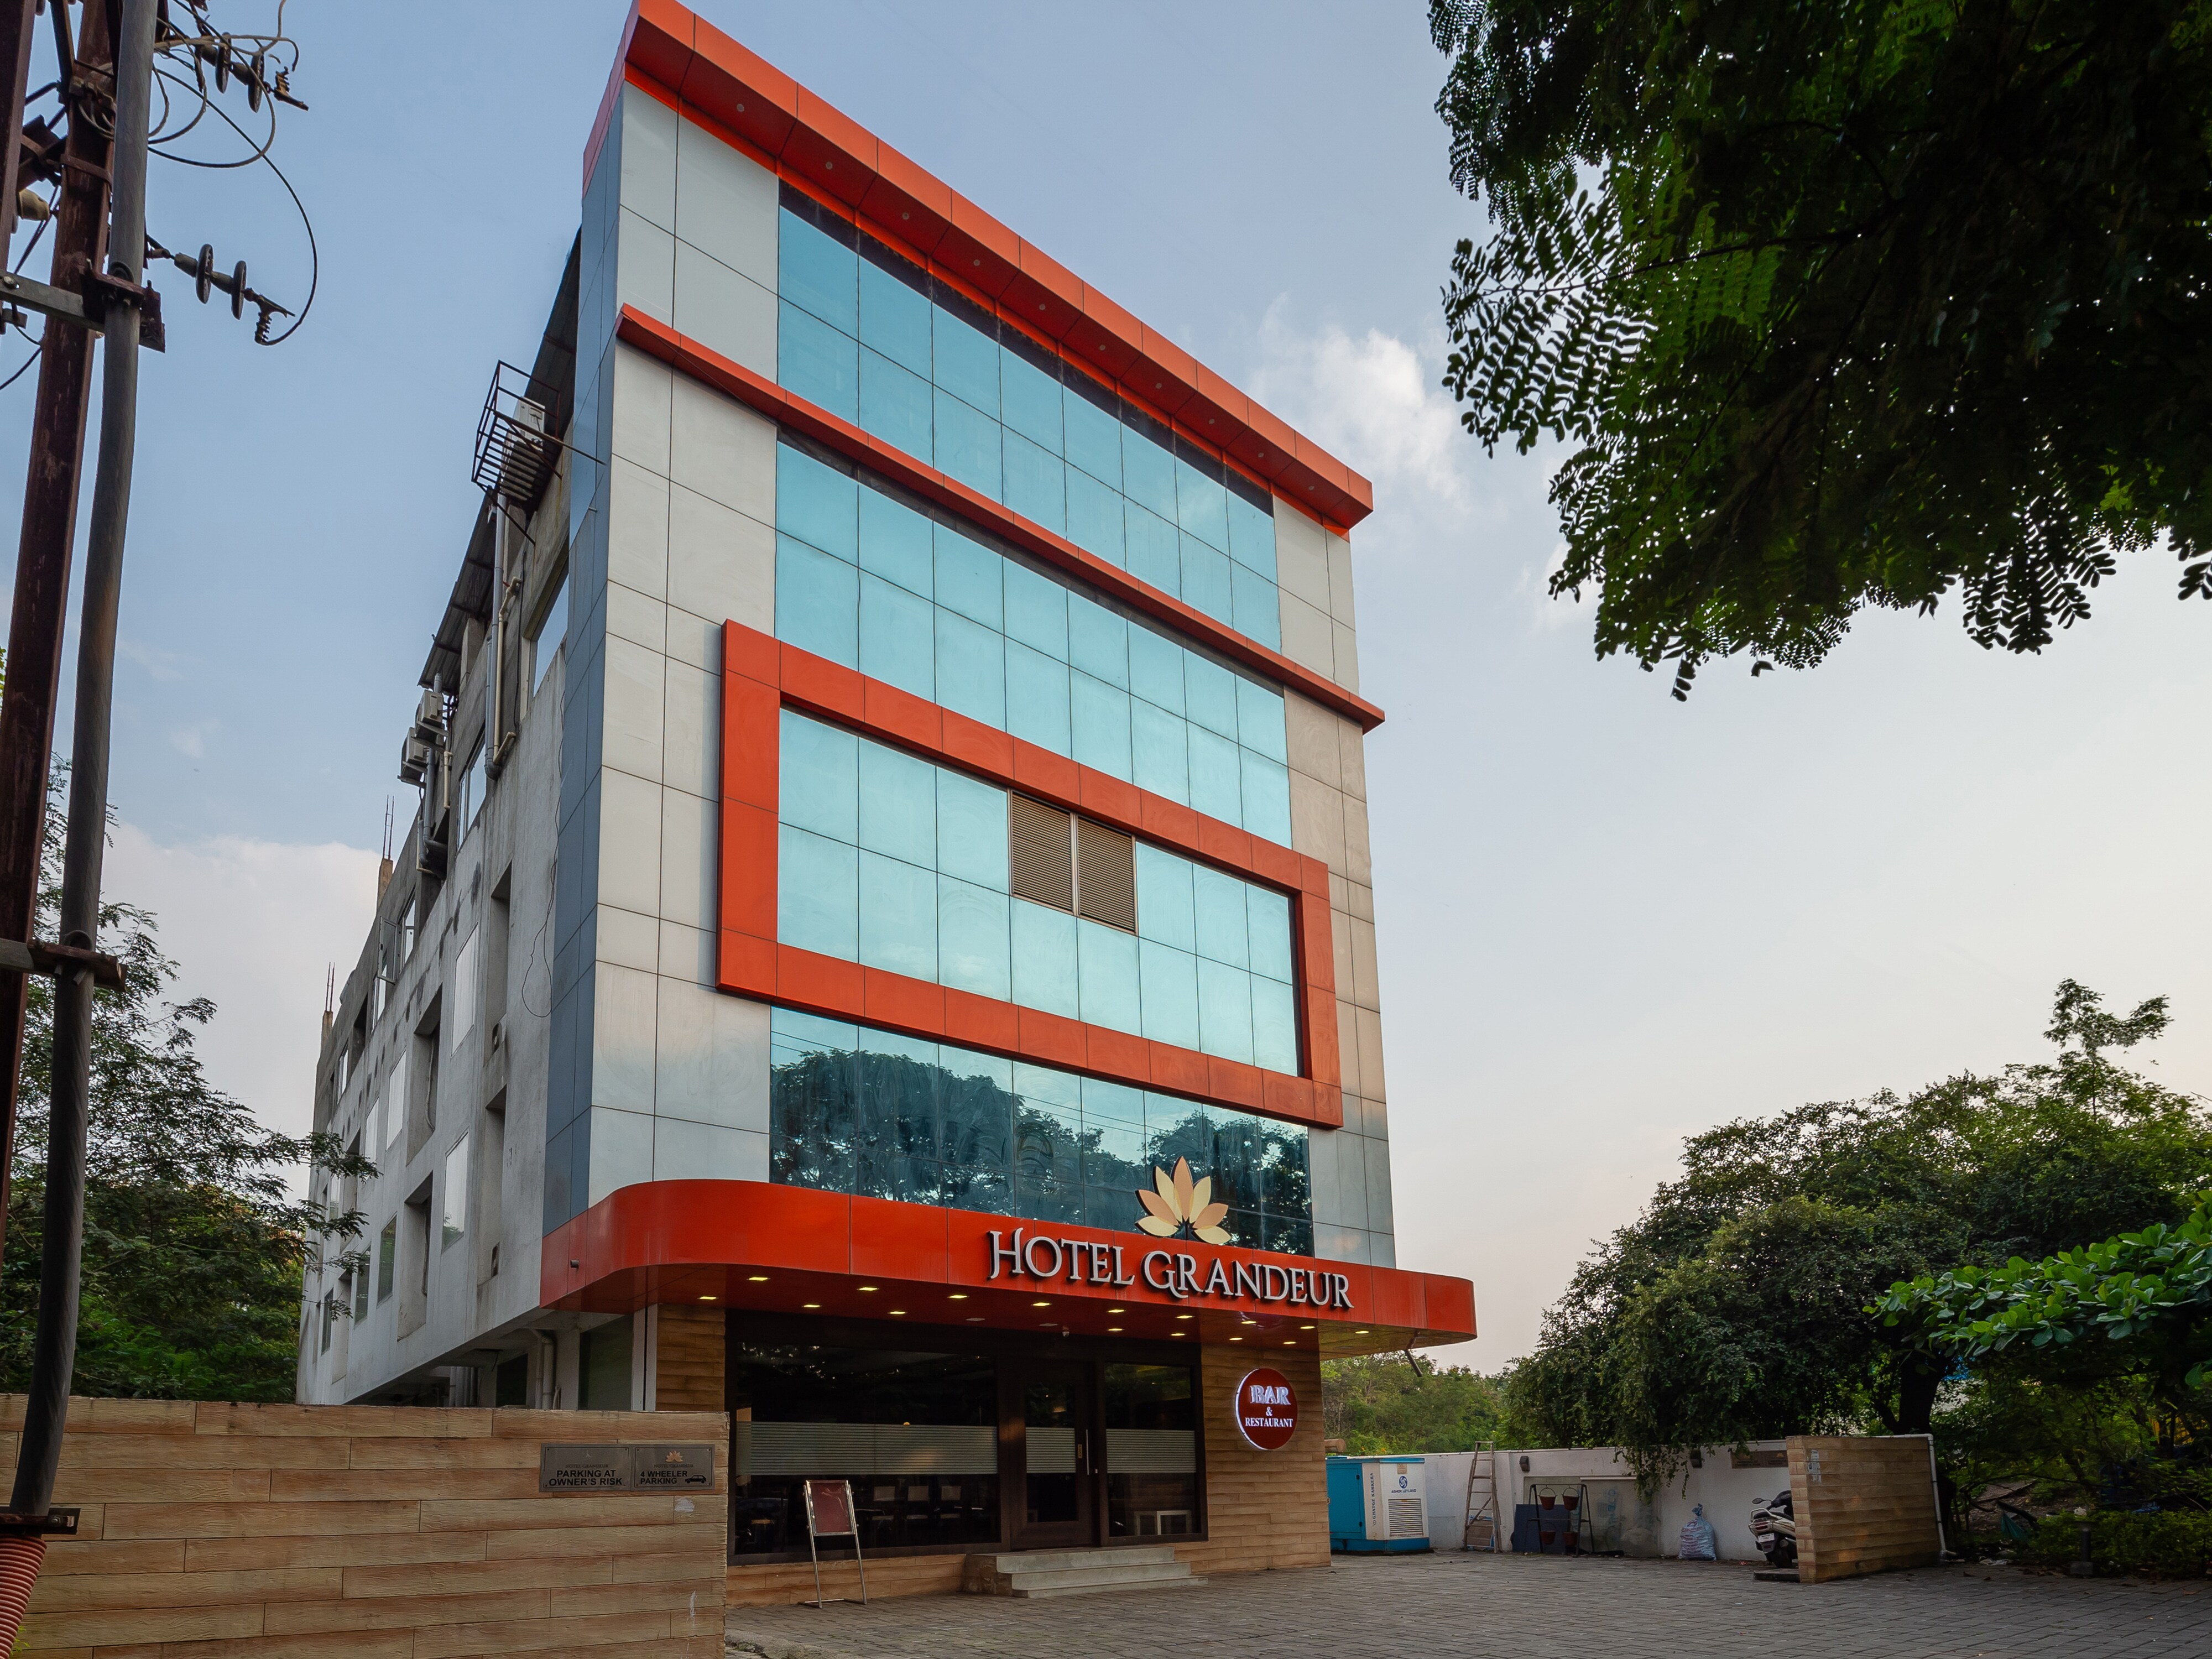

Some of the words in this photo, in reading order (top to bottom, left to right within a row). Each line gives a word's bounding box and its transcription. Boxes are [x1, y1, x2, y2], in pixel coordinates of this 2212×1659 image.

[988, 1227, 1135, 1286] HOTEL
[1141, 1250, 1355, 1309] GRANDEUR
[1249, 1385, 1291, 1405] BAR
[1265, 1406, 1273, 1417] &
[1245, 1417, 1293, 1427] RESTAURANT
[556, 1470, 602, 1478] PARKING
[549, 1478, 597, 1486] OWNER'S
[599, 1478, 623, 1486] RISK
